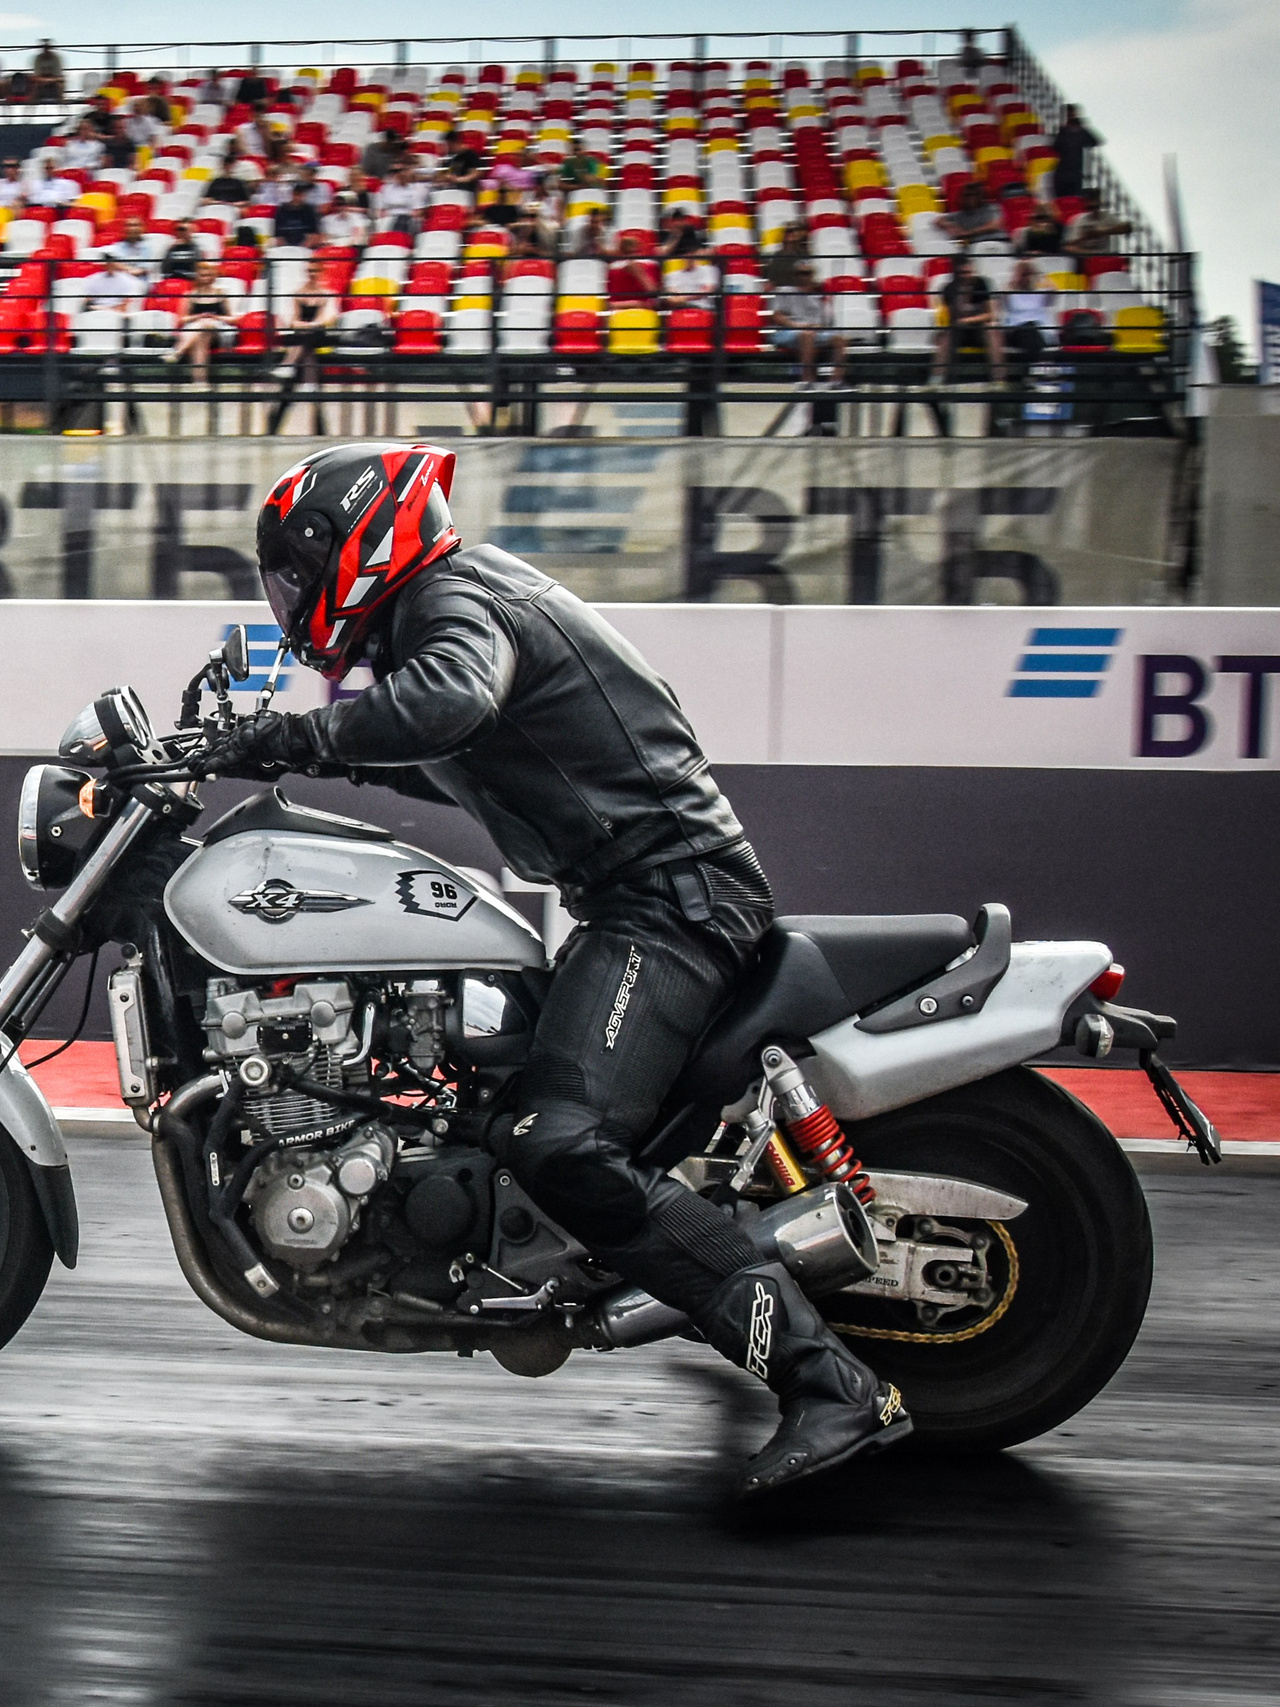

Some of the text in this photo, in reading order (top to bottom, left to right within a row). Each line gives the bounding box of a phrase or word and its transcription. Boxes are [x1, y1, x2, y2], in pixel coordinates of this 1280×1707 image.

[683, 487, 1062, 605] ВТБ
[430, 881, 458, 899] 96
[245, 892, 302, 908] X4
[278, 1130, 323, 1147] ARMOR
[862, 1275, 899, 1288] PEED
[746, 1282, 774, 1380] TCX
